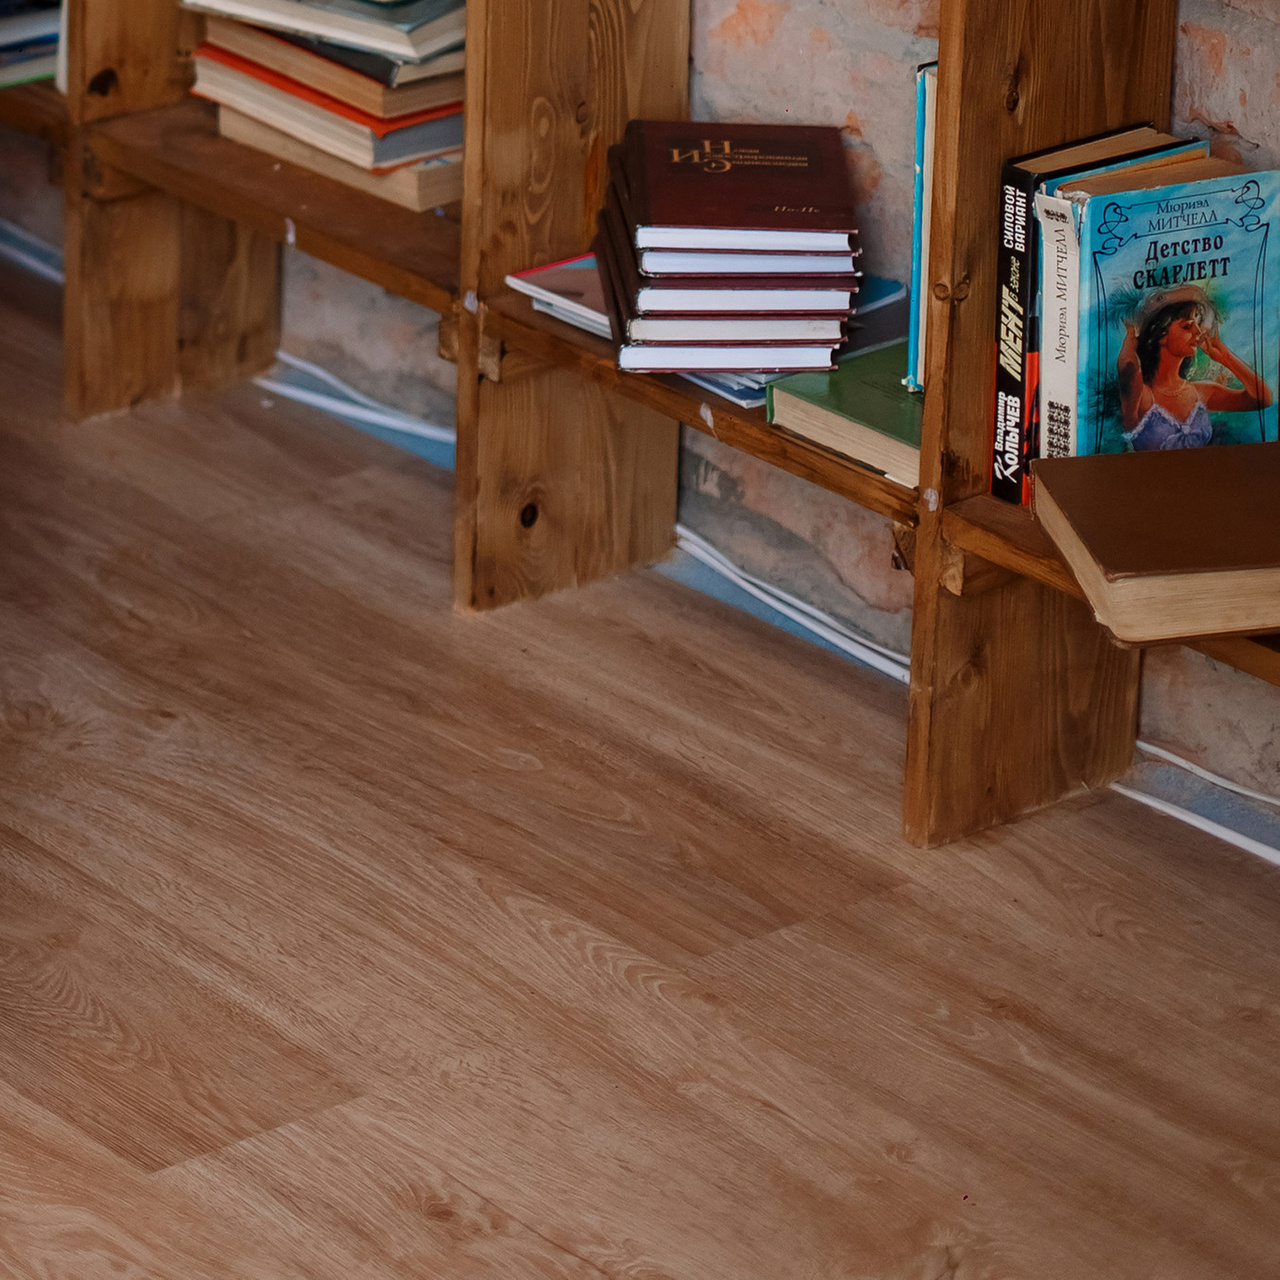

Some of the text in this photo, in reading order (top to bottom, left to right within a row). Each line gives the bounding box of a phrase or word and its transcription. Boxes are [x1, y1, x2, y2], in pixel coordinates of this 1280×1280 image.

[1002, 184, 1016, 250] СИЛОВОЙ
[1014, 188, 1028, 253] ВАРИАНТ
[1147, 210, 1219, 234] МИТЧЕЛЛ
[1155, 198, 1211, 216] Мюриэл
[1132, 256, 1232, 290] СКАРЛЕТТ
[1144, 233, 1225, 265] Детство
[1053, 228, 1071, 365] Мюриэл МИТЧЕЛЛ
[998, 283, 1025, 383] МЕНТ
[993, 391, 1008, 452] Владимир
[993, 394, 1022, 484] КОЛЫЧЕВ
